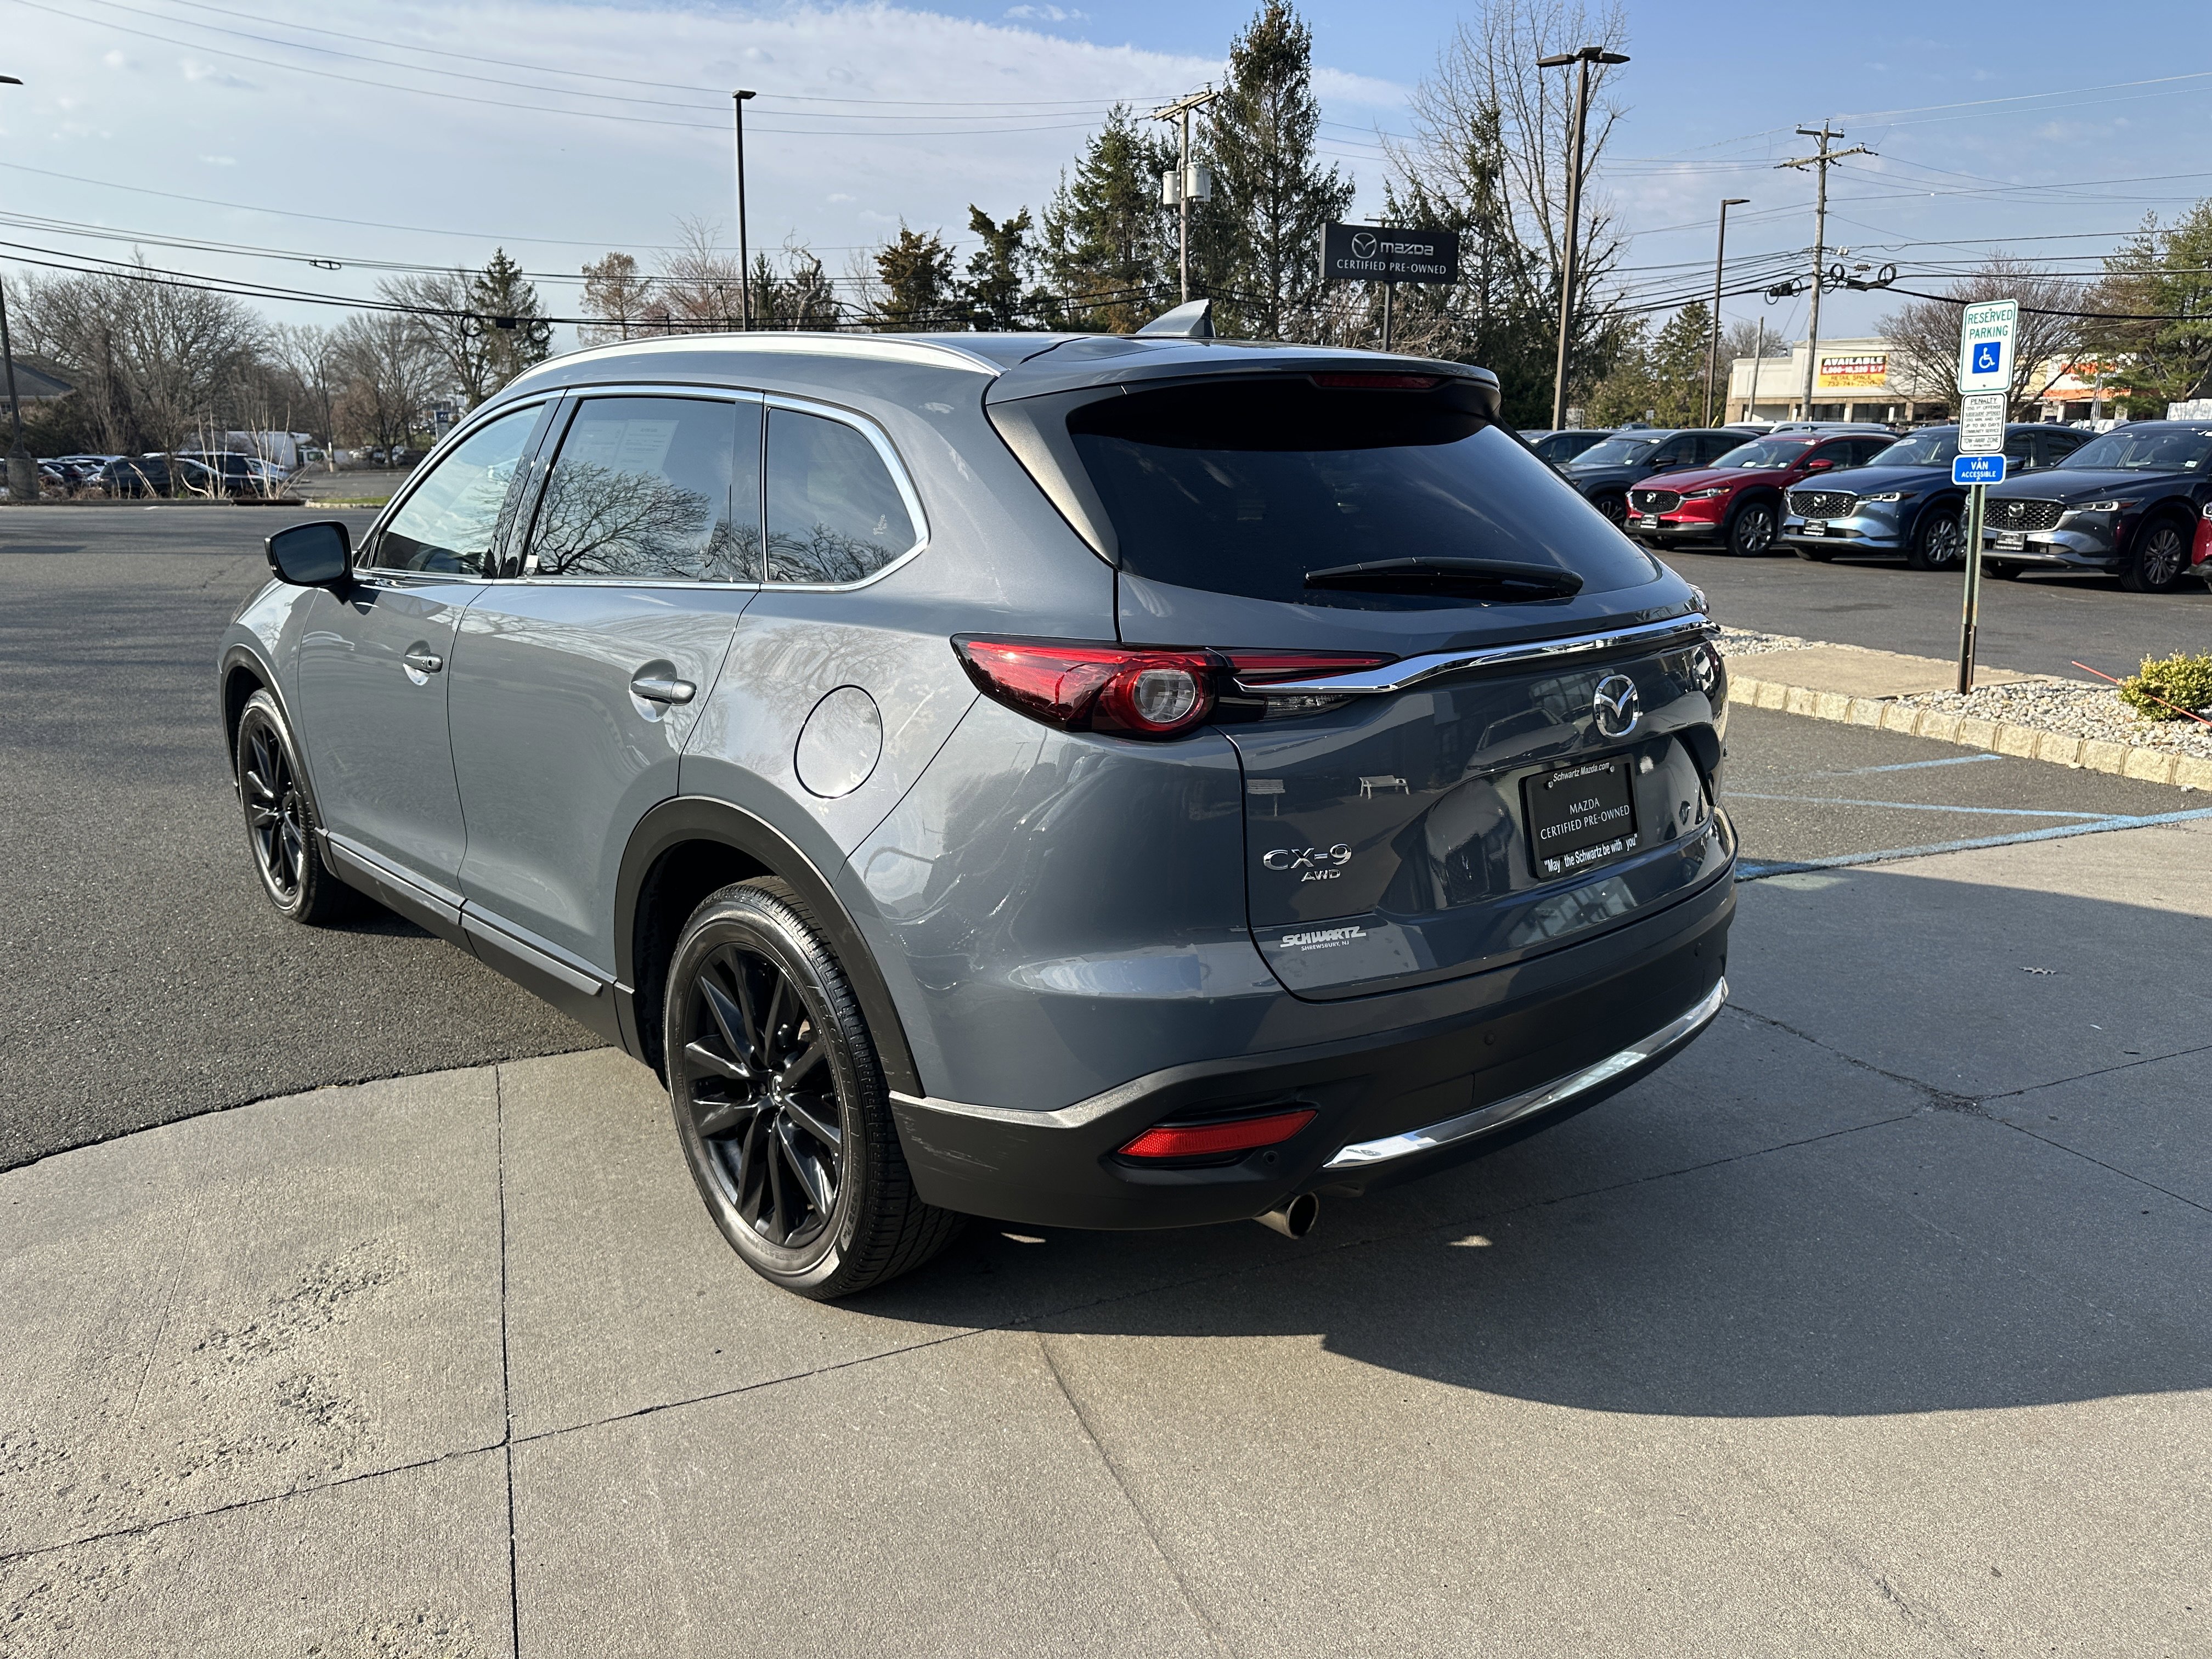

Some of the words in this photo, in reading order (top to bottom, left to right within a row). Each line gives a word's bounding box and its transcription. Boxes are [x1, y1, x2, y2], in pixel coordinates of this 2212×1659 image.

[1380, 242, 1434, 256] mazda
[1337, 259, 1386, 271] CERTIFIED
[1390, 262, 1446, 274] PRE-OWNED
[1968, 309, 2013, 325] RESERVED
[1969, 325, 2008, 340] PARKING
[1824, 357, 1883, 366] AVAILABLE
[1971, 461, 1988, 470] VAN
[1553, 769, 1579, 782] Schwartz
[1581, 762, 1610, 775] Mazda.com
[1570, 798, 1600, 815] MAZDA
[1541, 819, 1582, 839] CERTIFIED
[1584, 805, 1629, 827] PRE-OWNED
[1263, 843, 1352, 870] CX-9
[1564, 854, 1575, 867] the
[1575, 846, 1602, 864] Schwartz
[1602, 844, 1610, 856] be
[1610, 839, 1623, 853] with
[1301, 869, 1341, 882] AWD
[1280, 926, 1366, 947] SCHWARTZ
[1301, 941, 1340, 951] SHREWSBURY,
